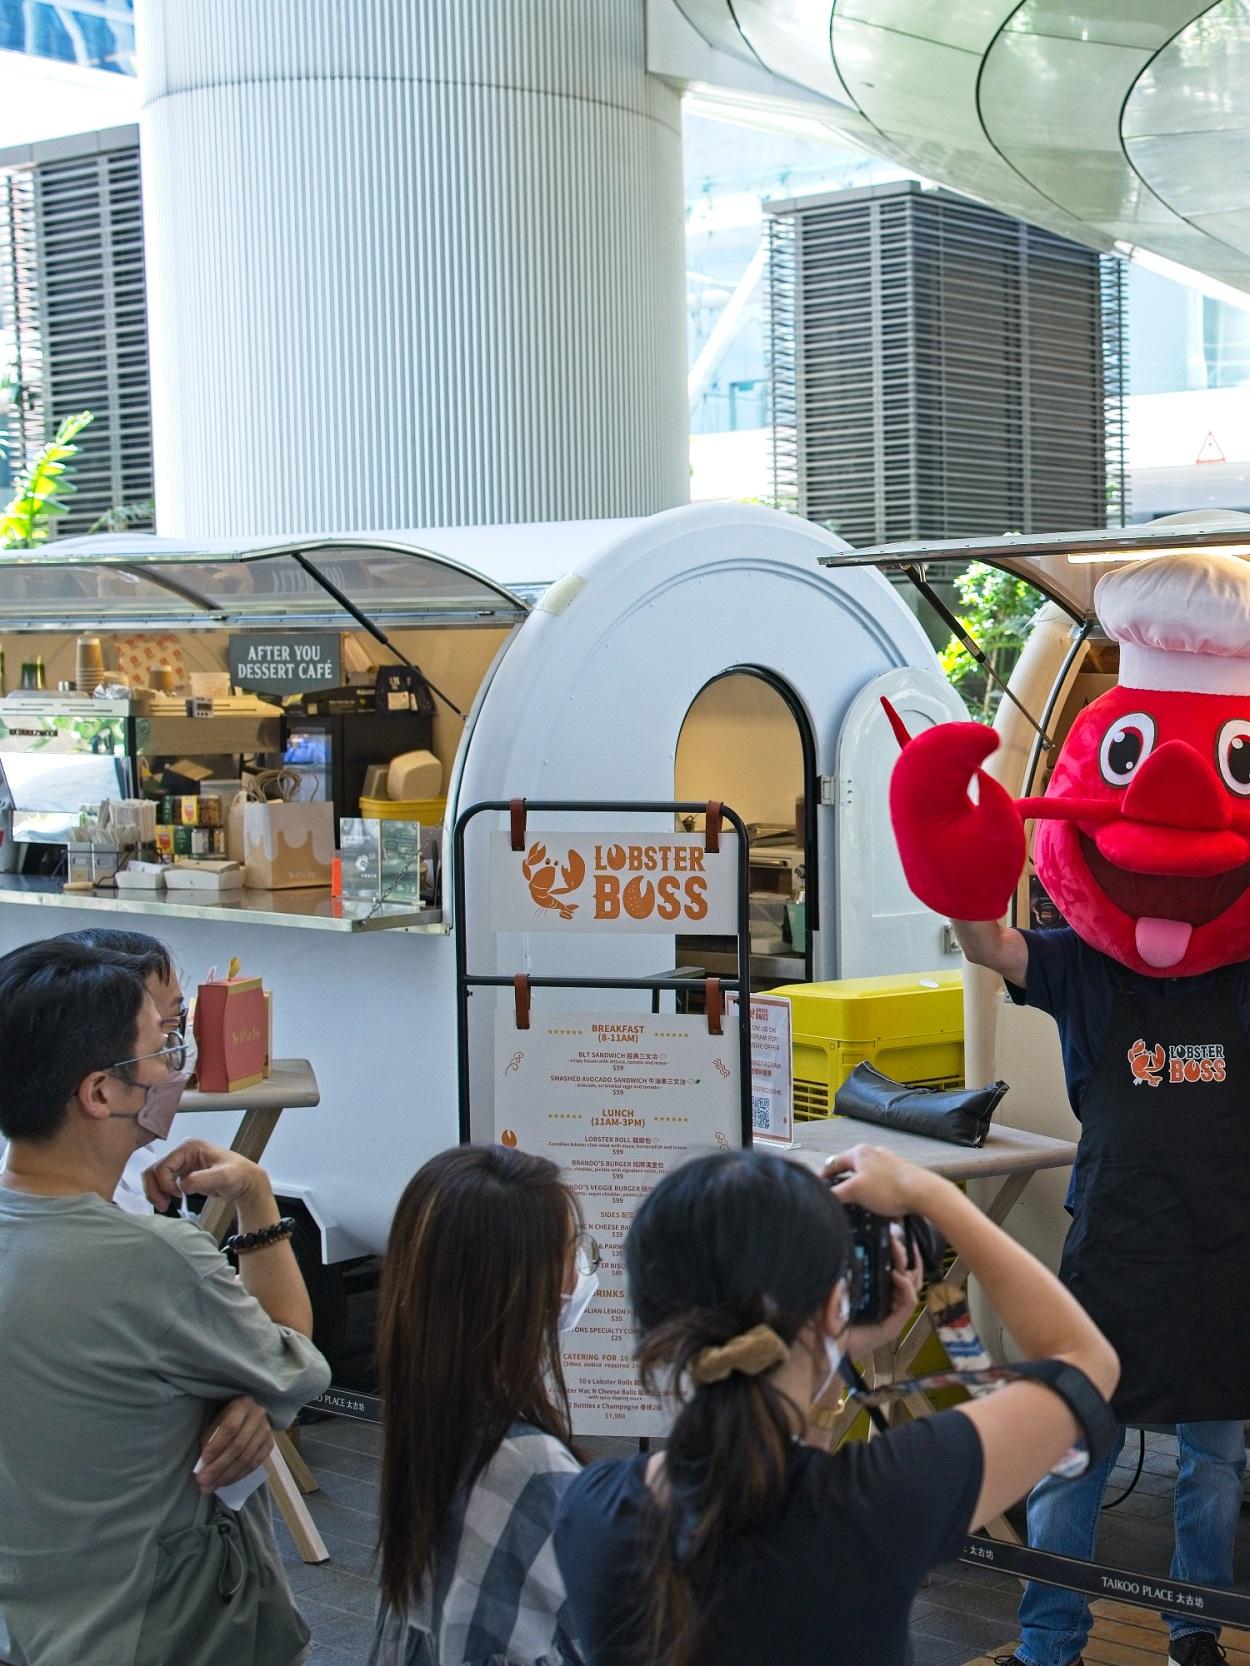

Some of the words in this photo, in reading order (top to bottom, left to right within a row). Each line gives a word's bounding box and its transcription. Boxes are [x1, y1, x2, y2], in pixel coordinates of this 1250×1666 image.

[247, 645, 290, 662] AFTER
[293, 645, 321, 661] YOU
[237, 663, 295, 679] DESSERT
[297, 659, 333, 679] CAFÉ
[593, 843, 706, 872] LOBSTER
[592, 874, 709, 921] BOSS
[591, 1023, 645, 1034] BREAKFAST
[597, 1033, 639, 1044] (8-11AM)
[591, 1052, 626, 1060] SANDWICH
[1168, 1043, 1225, 1060] LOBSTER
[1168, 1059, 1227, 1083] BOSS
[602, 1108, 635, 1118] LUNCH
[590, 1117, 646, 1129] (11AM-3PM)
[584, 1135, 614, 1143] LOBSTER
[571, 1159, 605, 1167] BRANDO'S
[590, 1184, 613, 1192] VEGGIE
[589, 1327, 624, 1335] SPECIALTY
[563, 1353, 599, 1361] CATERING
[602, 1353, 617, 1361] FOR
[324, 1394, 346, 1408] PLACE
[346, 1399, 366, 1412] 太古坊
[601, 1403, 639, 1411] Champagne
[969, 1544, 995, 1561] 太古坊
[1100, 1575, 1140, 1595] TAIKOO
[1142, 1584, 1174, 1602] PLACE
[1175, 1592, 1205, 1609] 太古坊
